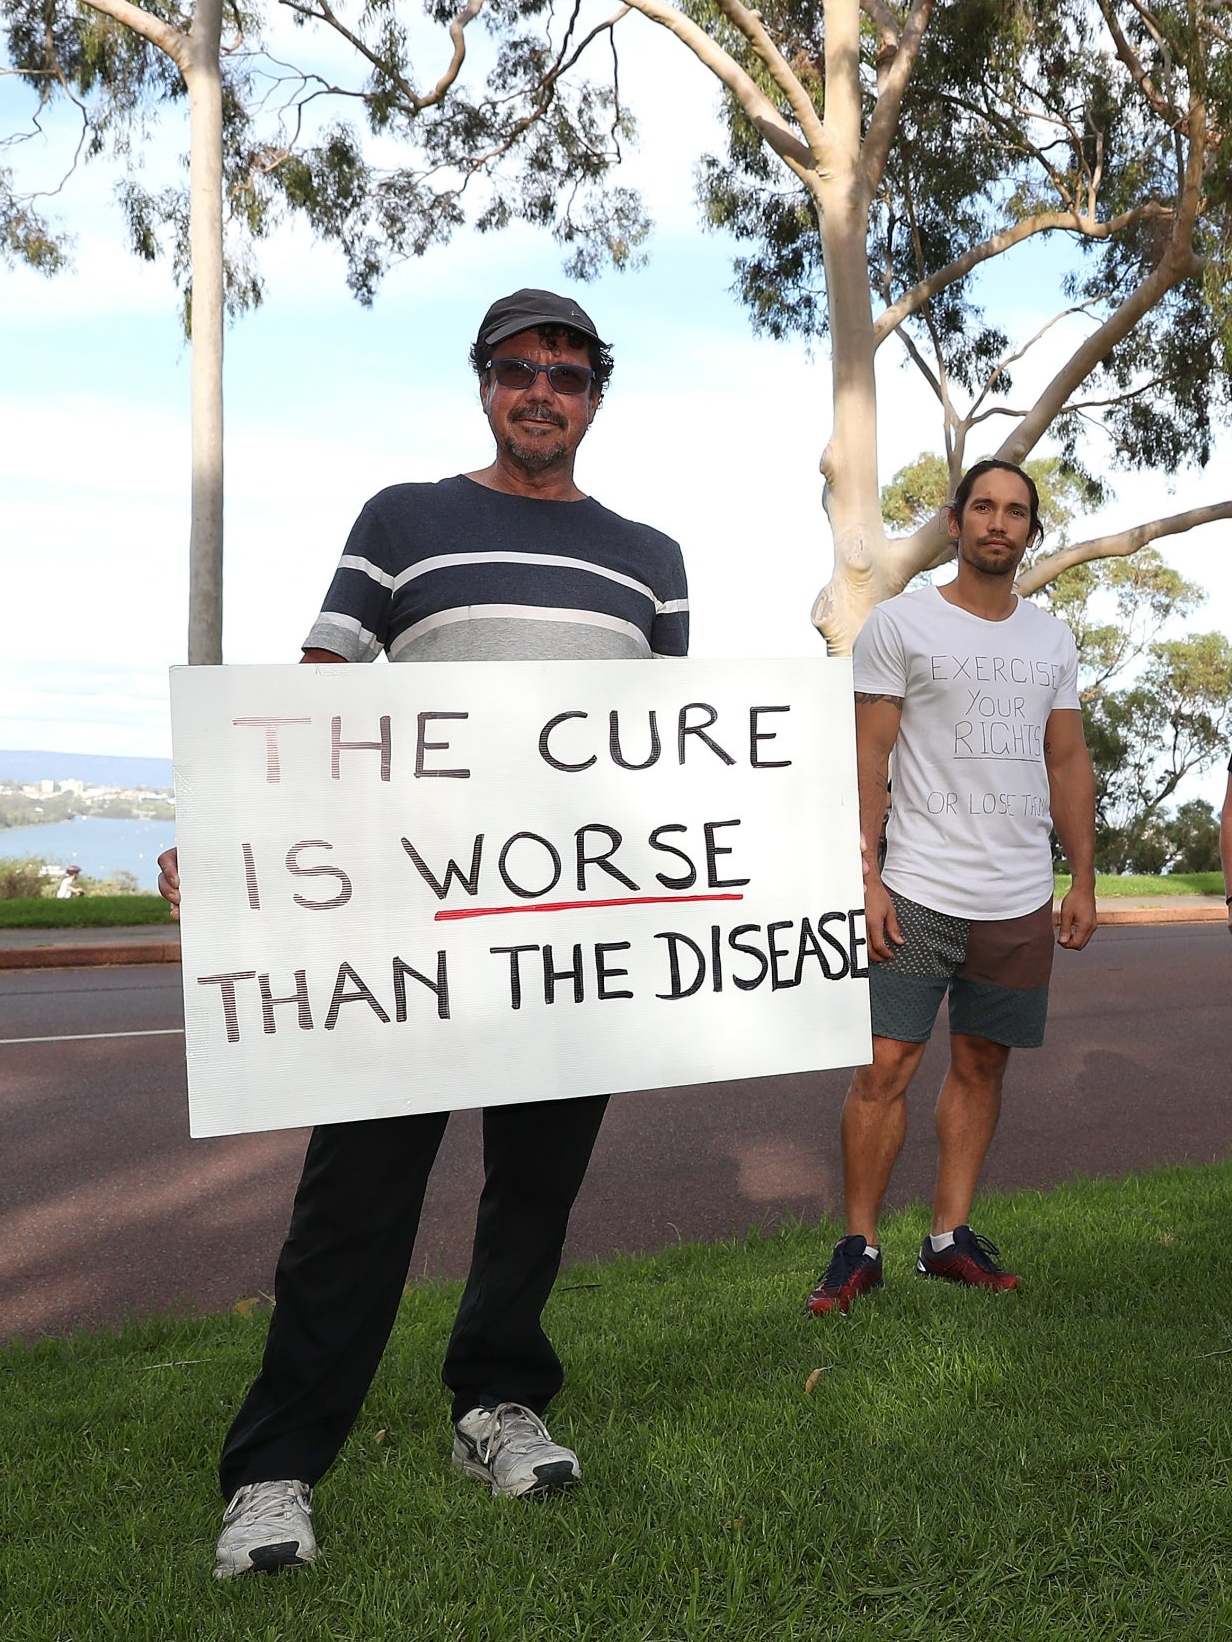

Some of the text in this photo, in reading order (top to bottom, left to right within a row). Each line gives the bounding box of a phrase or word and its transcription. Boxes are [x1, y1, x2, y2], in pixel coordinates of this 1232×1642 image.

[931, 655, 1060, 691] EXERCISE
[964, 689, 1025, 718] YOUR
[232, 702, 792, 783] THE CURE
[954, 720, 1042, 757] RIGHTS
[927, 791, 958, 816] OR
[969, 793, 1016, 816] LOSE
[244, 819, 751, 911] IS WORSE
[197, 908, 869, 1043] THAN THE DISEASE
